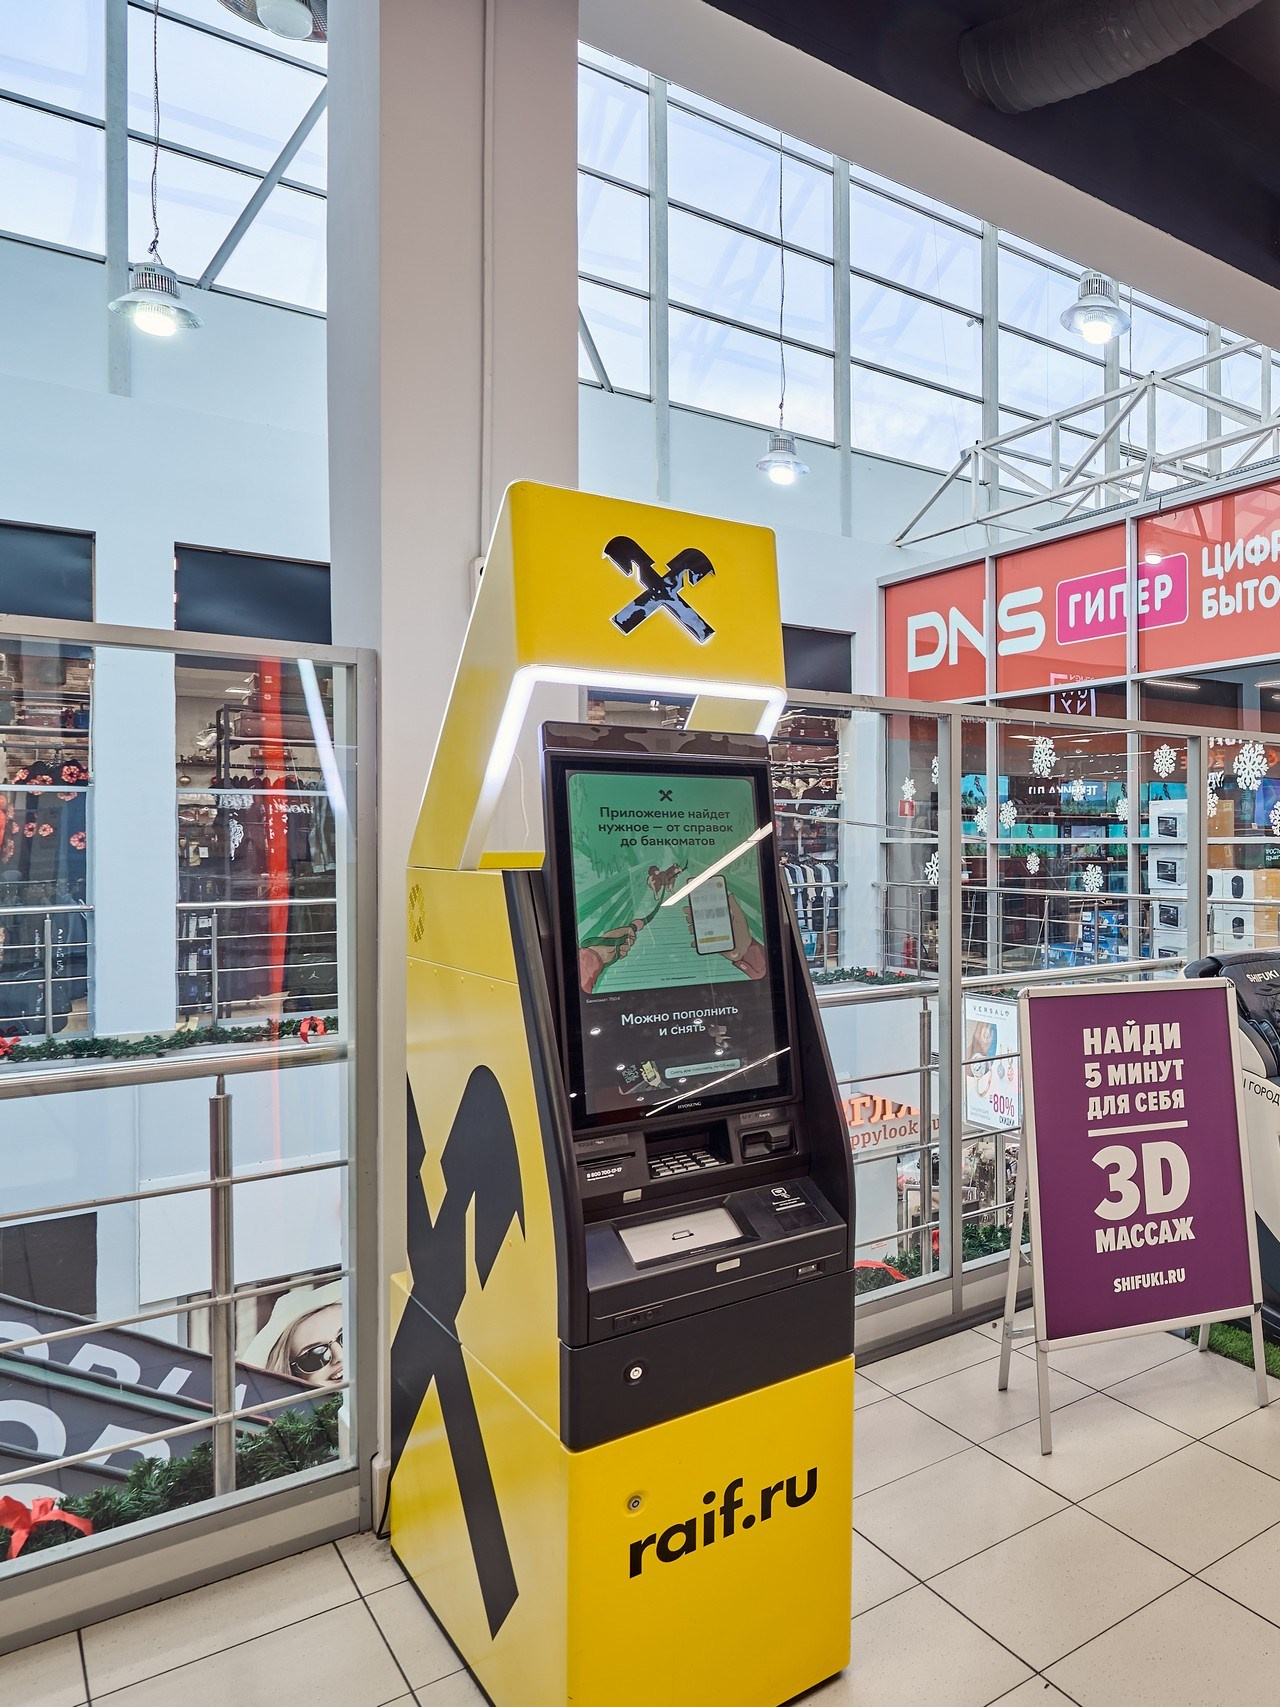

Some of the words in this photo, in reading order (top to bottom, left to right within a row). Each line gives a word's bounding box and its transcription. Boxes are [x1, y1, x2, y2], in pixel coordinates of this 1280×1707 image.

[906, 586, 1046, 673] DNS
[1067, 573, 1173, 628] ГИПЕР
[599, 806, 685, 821] Приложение
[688, 808, 731, 820] найдет
[598, 823, 650, 834] нужное
[666, 824, 680, 833] от
[684, 823, 734, 836] справок
[620, 837, 637, 848] до
[641, 835, 716, 847] банкоматов
[1246, 969, 1280, 983] SHIFUKI
[621, 1013, 670, 1026] Можно
[672, 1006, 739, 1021] пополнить
[659, 1027, 667, 1036] и
[670, 1024, 706, 1036] снять
[1082, 1019, 1182, 1056] НАЙДИ
[1084, 1062, 1102, 1088] 5
[1108, 1058, 1184, 1086] МИНУТ
[1087, 1094, 1130, 1121] ДЛЯ
[1134, 1088, 1185, 1112] СЕБЯ
[1092, 1140, 1191, 1220] 3D
[1095, 1216, 1196, 1254] МАССАЖ
[1113, 1268, 1186, 1293] SHIFUKI.RU
[629, 1466, 818, 1579] raif.ru
